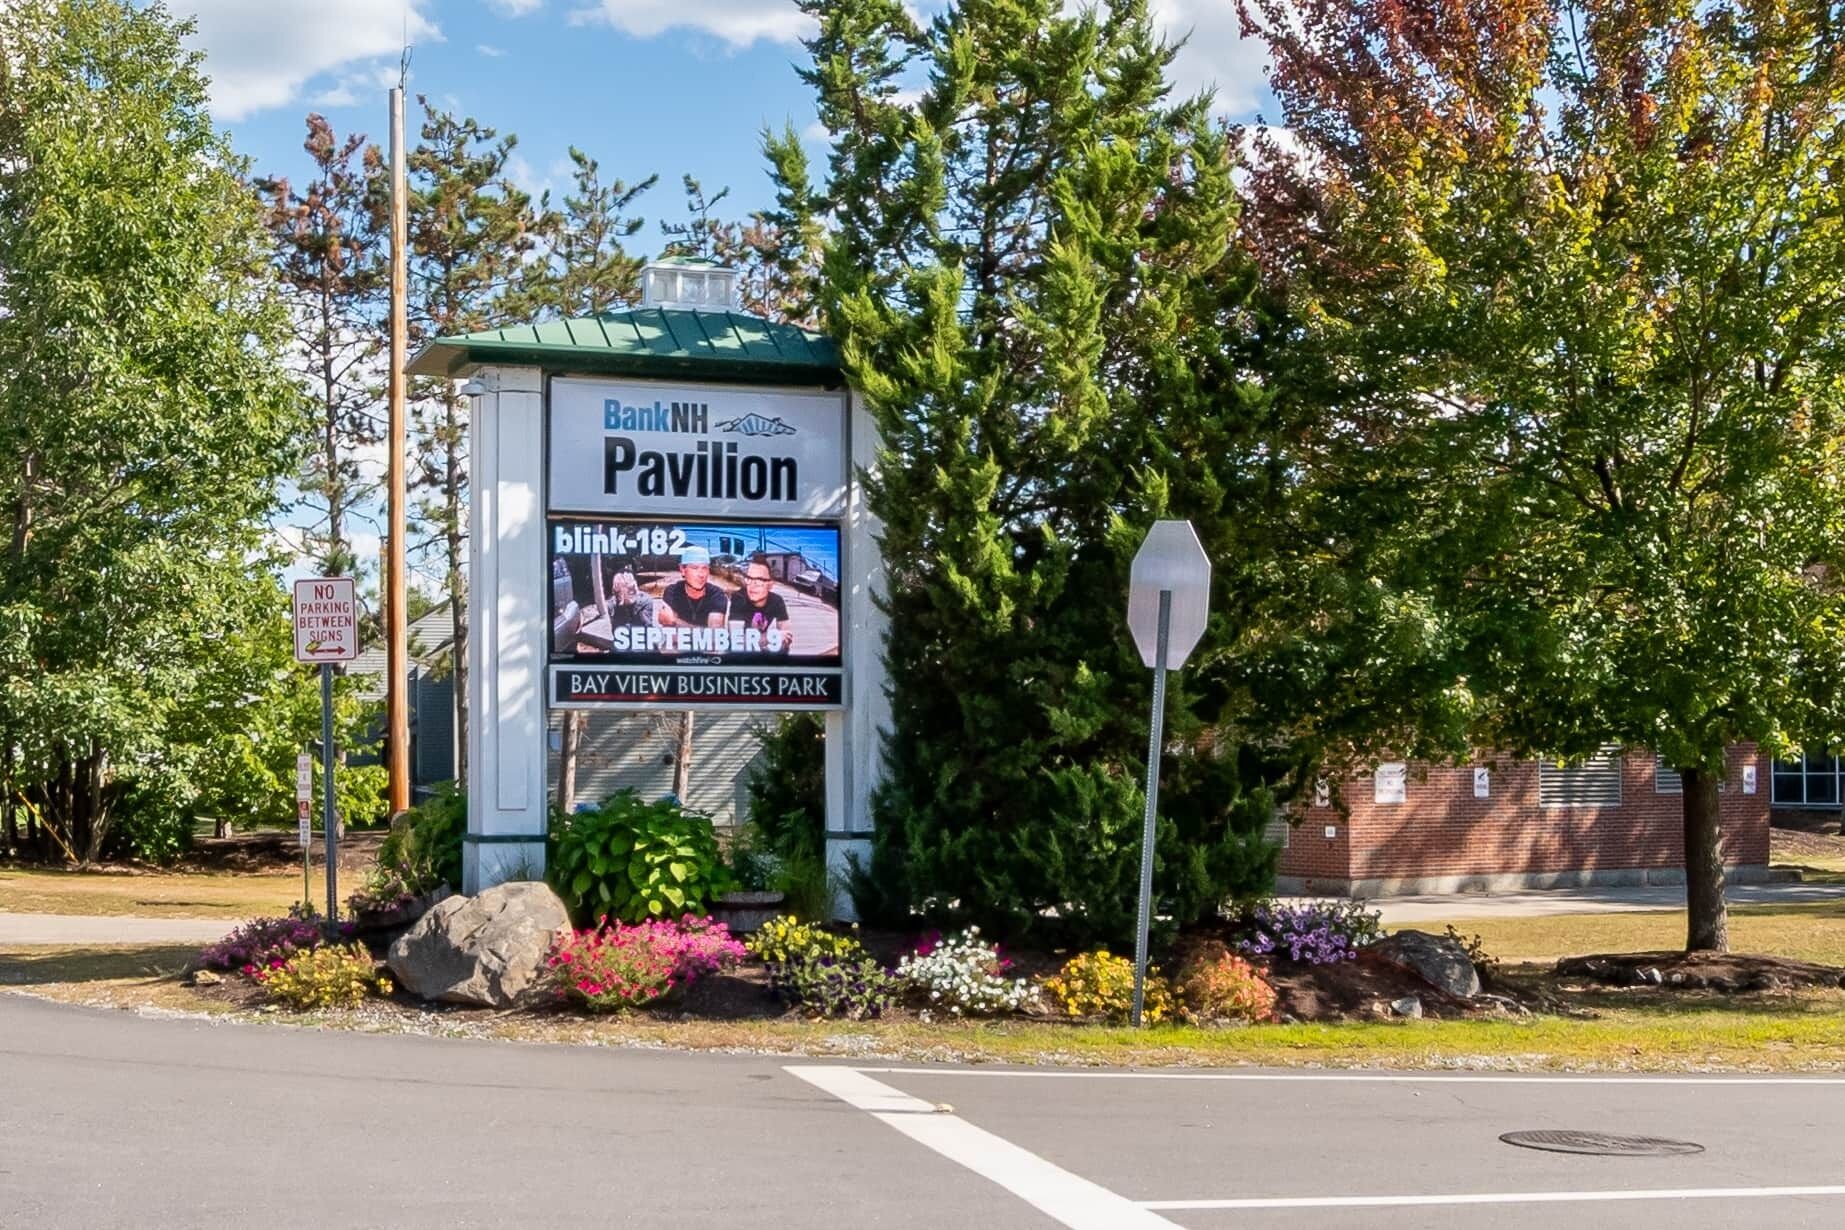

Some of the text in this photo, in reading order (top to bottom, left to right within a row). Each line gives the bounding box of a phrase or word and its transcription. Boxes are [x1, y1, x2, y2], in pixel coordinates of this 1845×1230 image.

[603, 436, 798, 501] Pavilion
[555, 525, 687, 556] blink-182
[314, 585, 335, 600] NO
[300, 602, 350, 614] PARKING
[300, 616, 352, 628] BETWEEN
[310, 630, 343, 641] SIGNS
[613, 627, 783, 652] SEPTEMBER 9
[571, 674, 828, 696] BAY VIEW BUSINESS PARK
